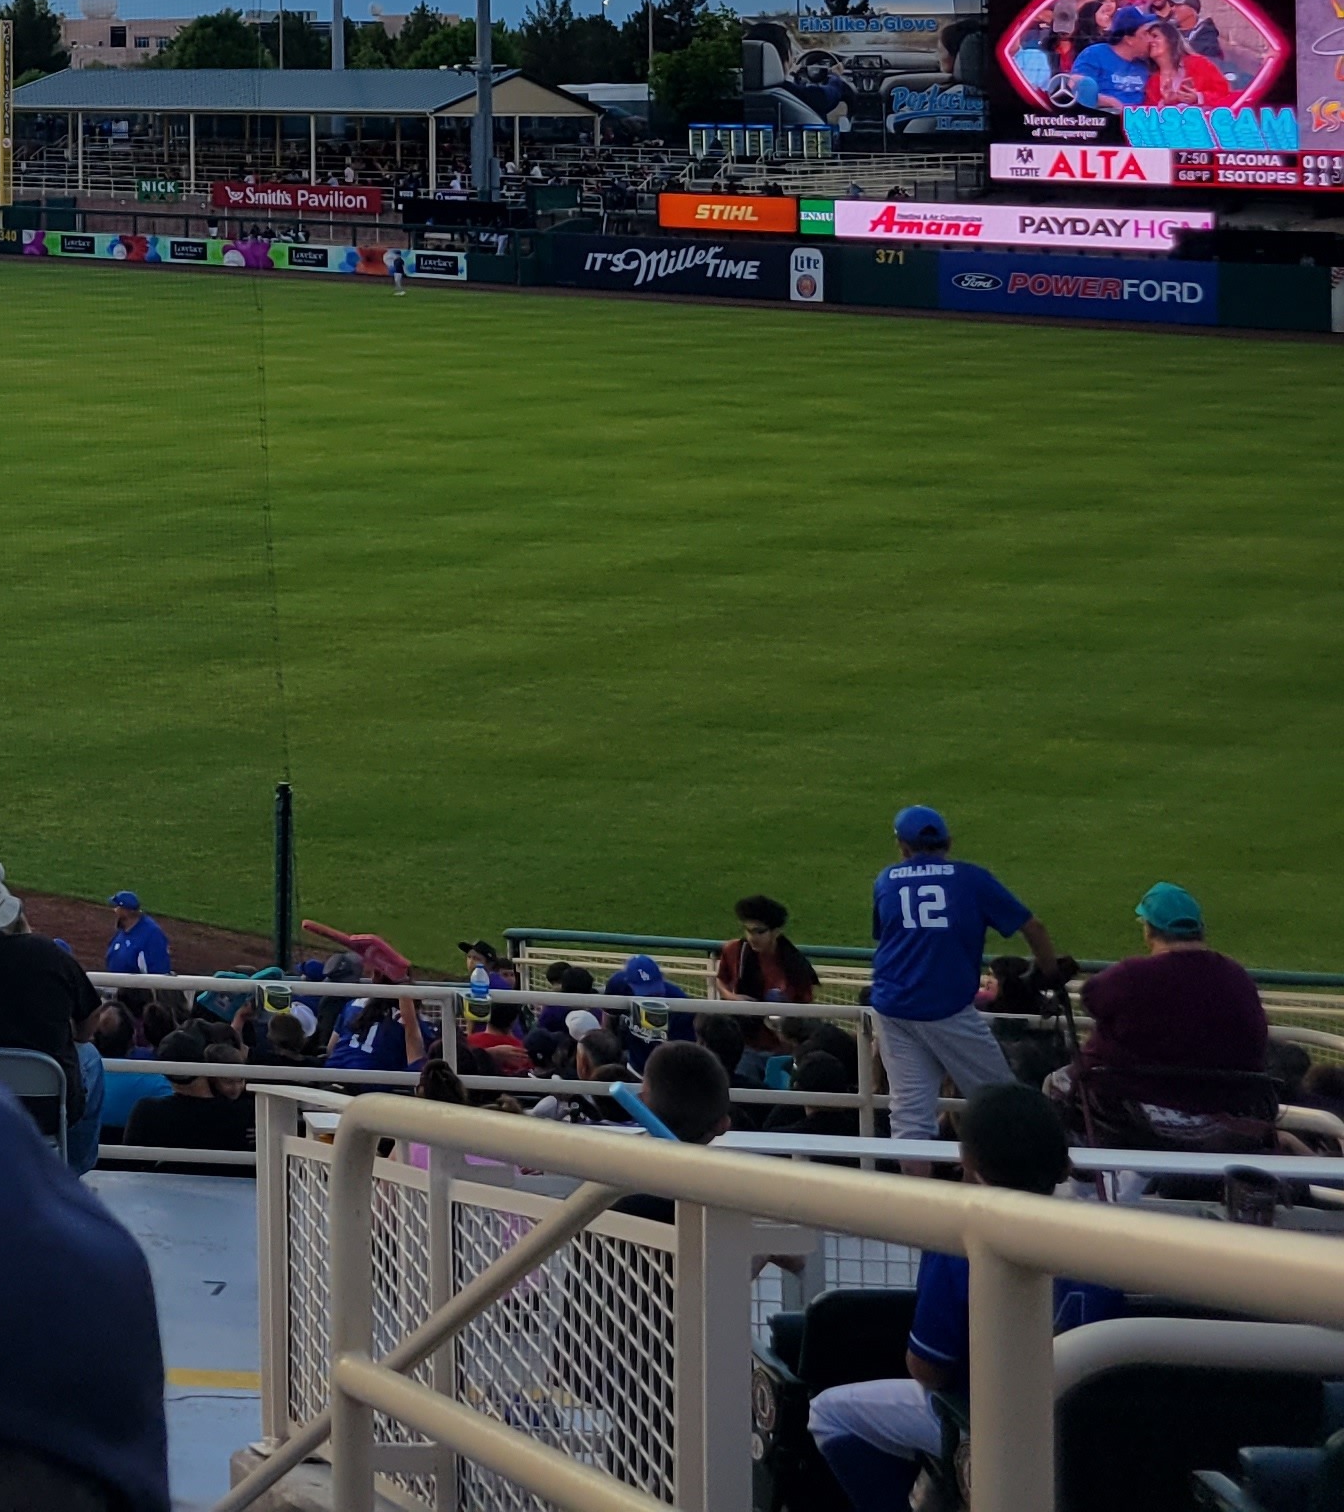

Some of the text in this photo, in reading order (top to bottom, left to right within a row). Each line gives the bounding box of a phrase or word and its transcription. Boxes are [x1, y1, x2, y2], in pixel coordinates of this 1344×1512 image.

[798, 16, 938, 32] Fits like a Glove
[1023, 114, 1107, 127] Mercedes-Benz
[1123, 106, 1300, 151] KISS CAM
[1031, 128, 1041, 137] of
[1047, 150, 1147, 181] ALTA
[1178, 152, 1208, 164] 7:50
[1217, 153, 1342, 169] TACOMA 0 0 1
[1009, 166, 1041, 177] TECATE
[1217, 169, 1297, 184] ISOTOPES
[1303, 172, 1314, 186] 2
[1318, 172, 1329, 186] 1
[141, 180, 176, 194] NICK
[245, 187, 368, 209] Smith's Pavilion
[695, 204, 759, 221] STIHL
[800, 211, 834, 222] ENMU
[868, 205, 984, 236] Amana
[1018, 215, 1130, 237] PAYDAY
[793, 255, 820, 272] Lite
[875, 248, 905, 265] 371
[584, 245, 762, 286] IT'S Miller TIME
[961, 274, 993, 288] Ford
[888, 863, 955, 879] COLLINS
[898, 884, 949, 929] 12
[202, 1280, 227, 1295] 7
